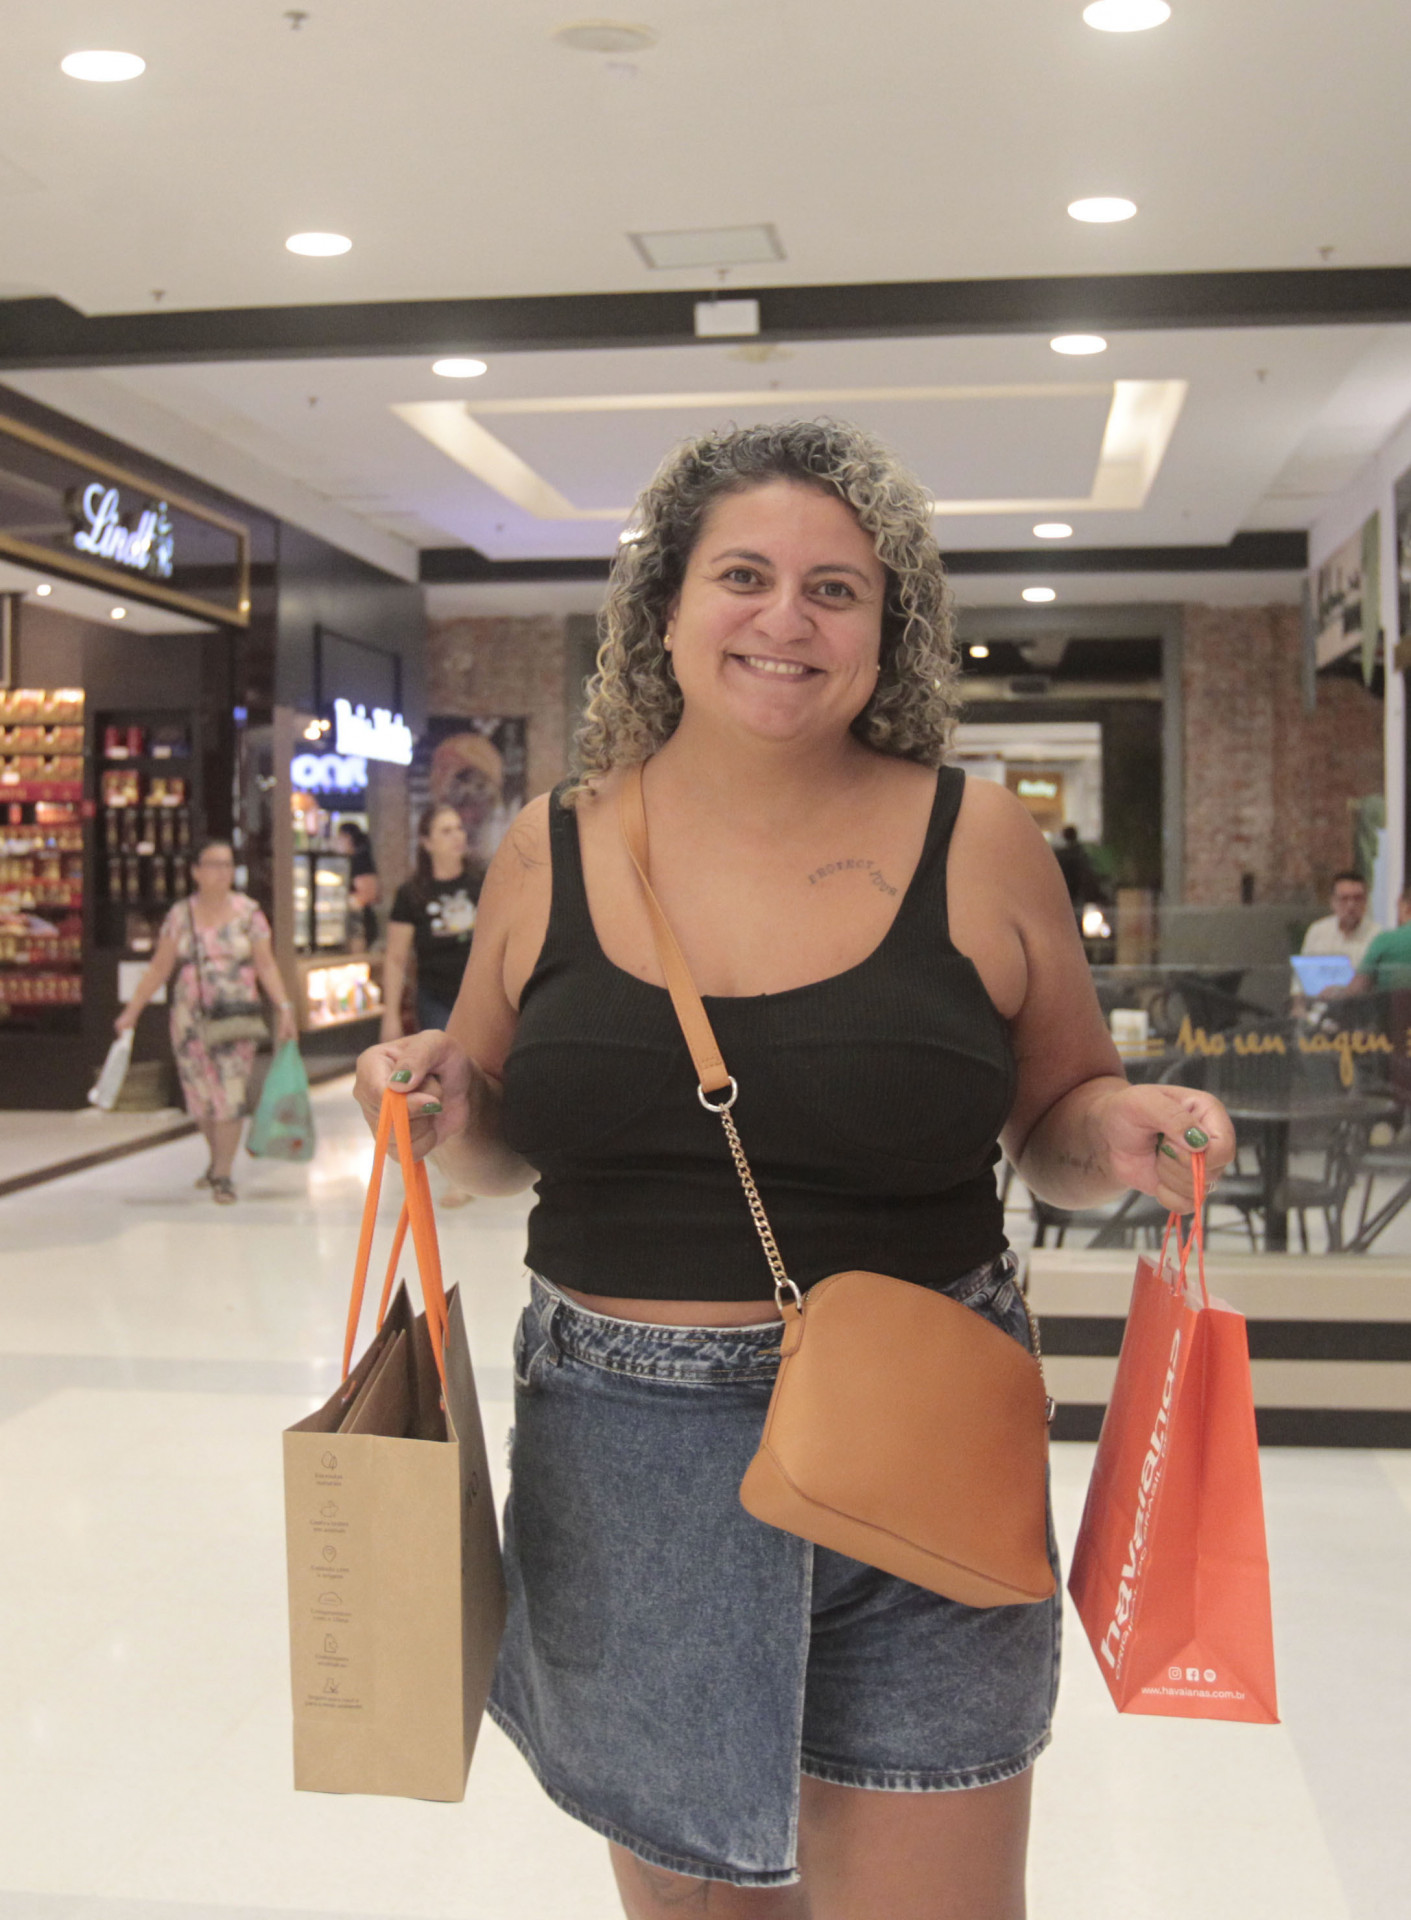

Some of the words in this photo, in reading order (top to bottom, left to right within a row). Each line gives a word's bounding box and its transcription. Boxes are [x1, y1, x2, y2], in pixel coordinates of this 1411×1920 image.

[74, 483, 158, 569] Lindt
[1100, 1328, 1181, 1669] havaianas
[1141, 1685, 1246, 1700] www.havaianas.com.br
